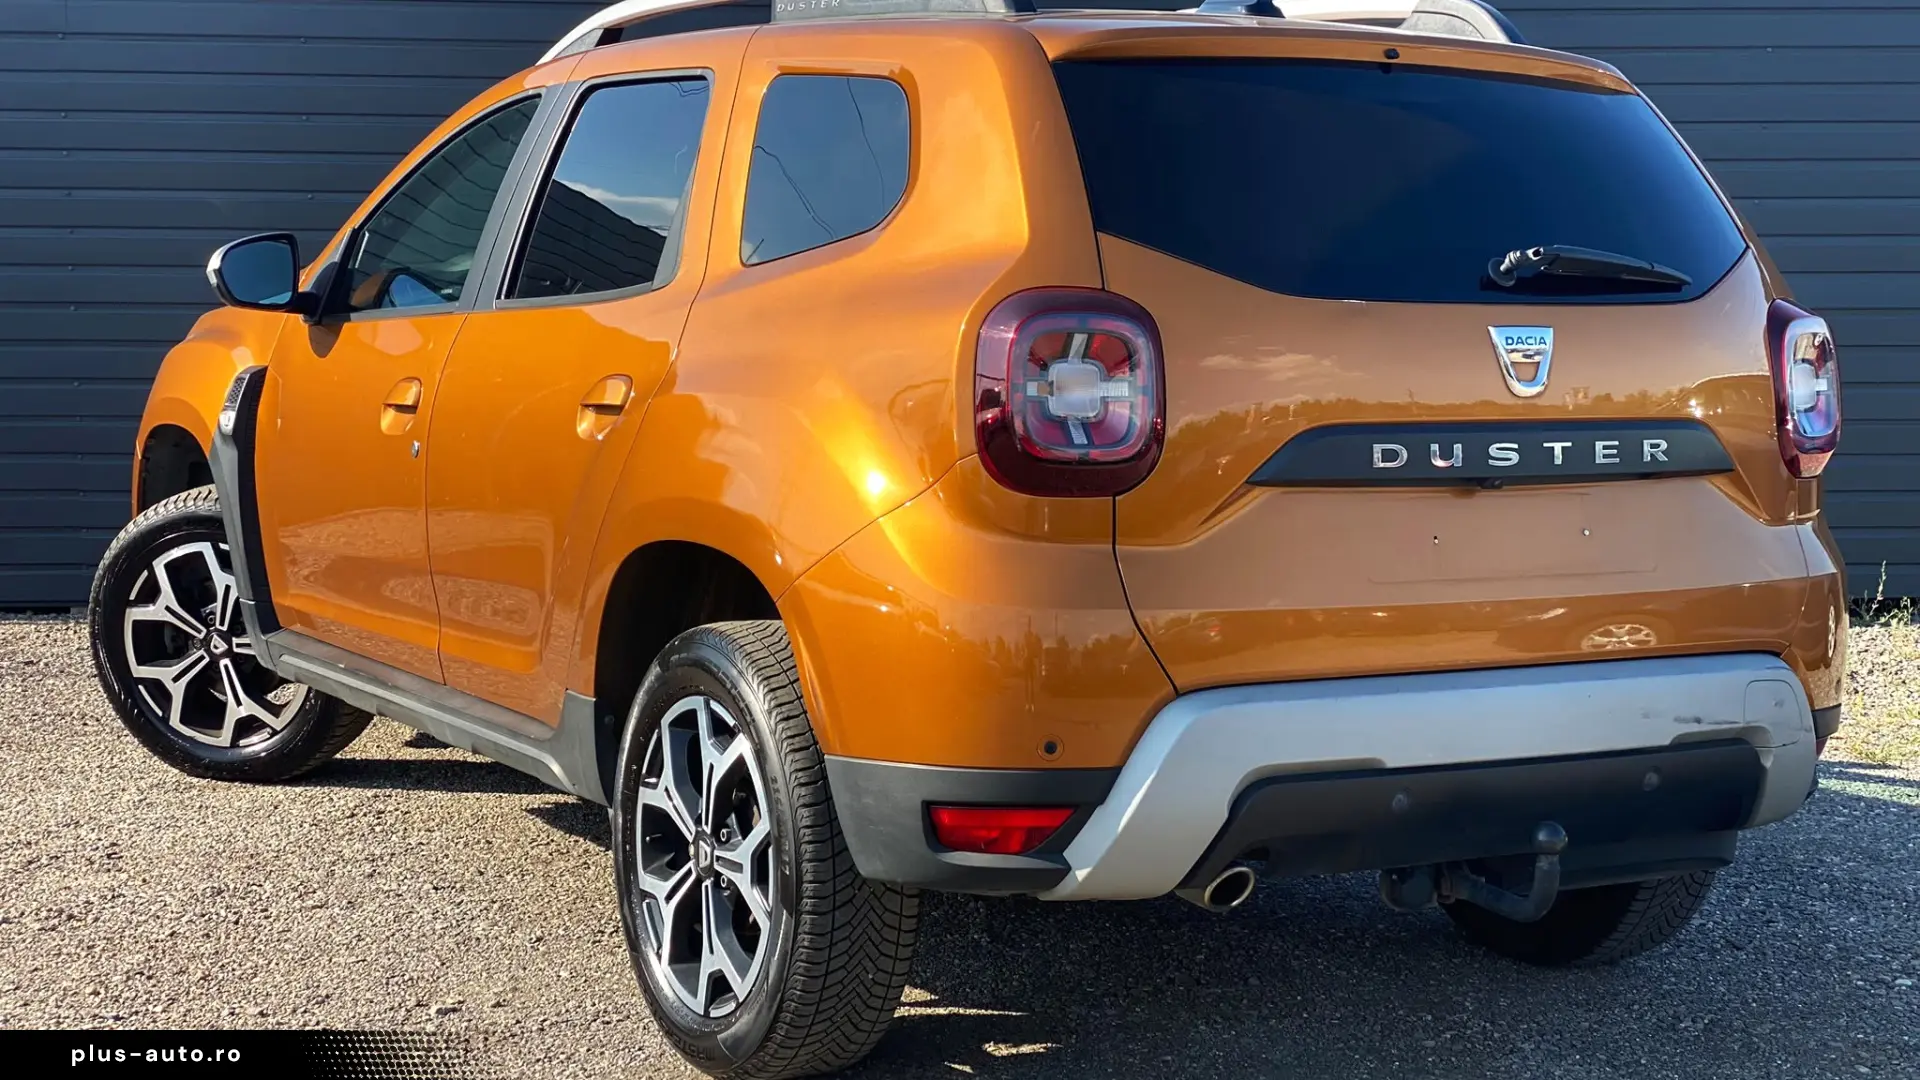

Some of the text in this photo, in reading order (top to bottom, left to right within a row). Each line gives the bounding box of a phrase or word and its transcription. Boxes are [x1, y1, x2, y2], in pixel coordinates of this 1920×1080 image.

[776, 0, 840, 12] DUSTER
[1504, 336, 1548, 347] DACIA
[1372, 438, 1669, 469] DUSTER
